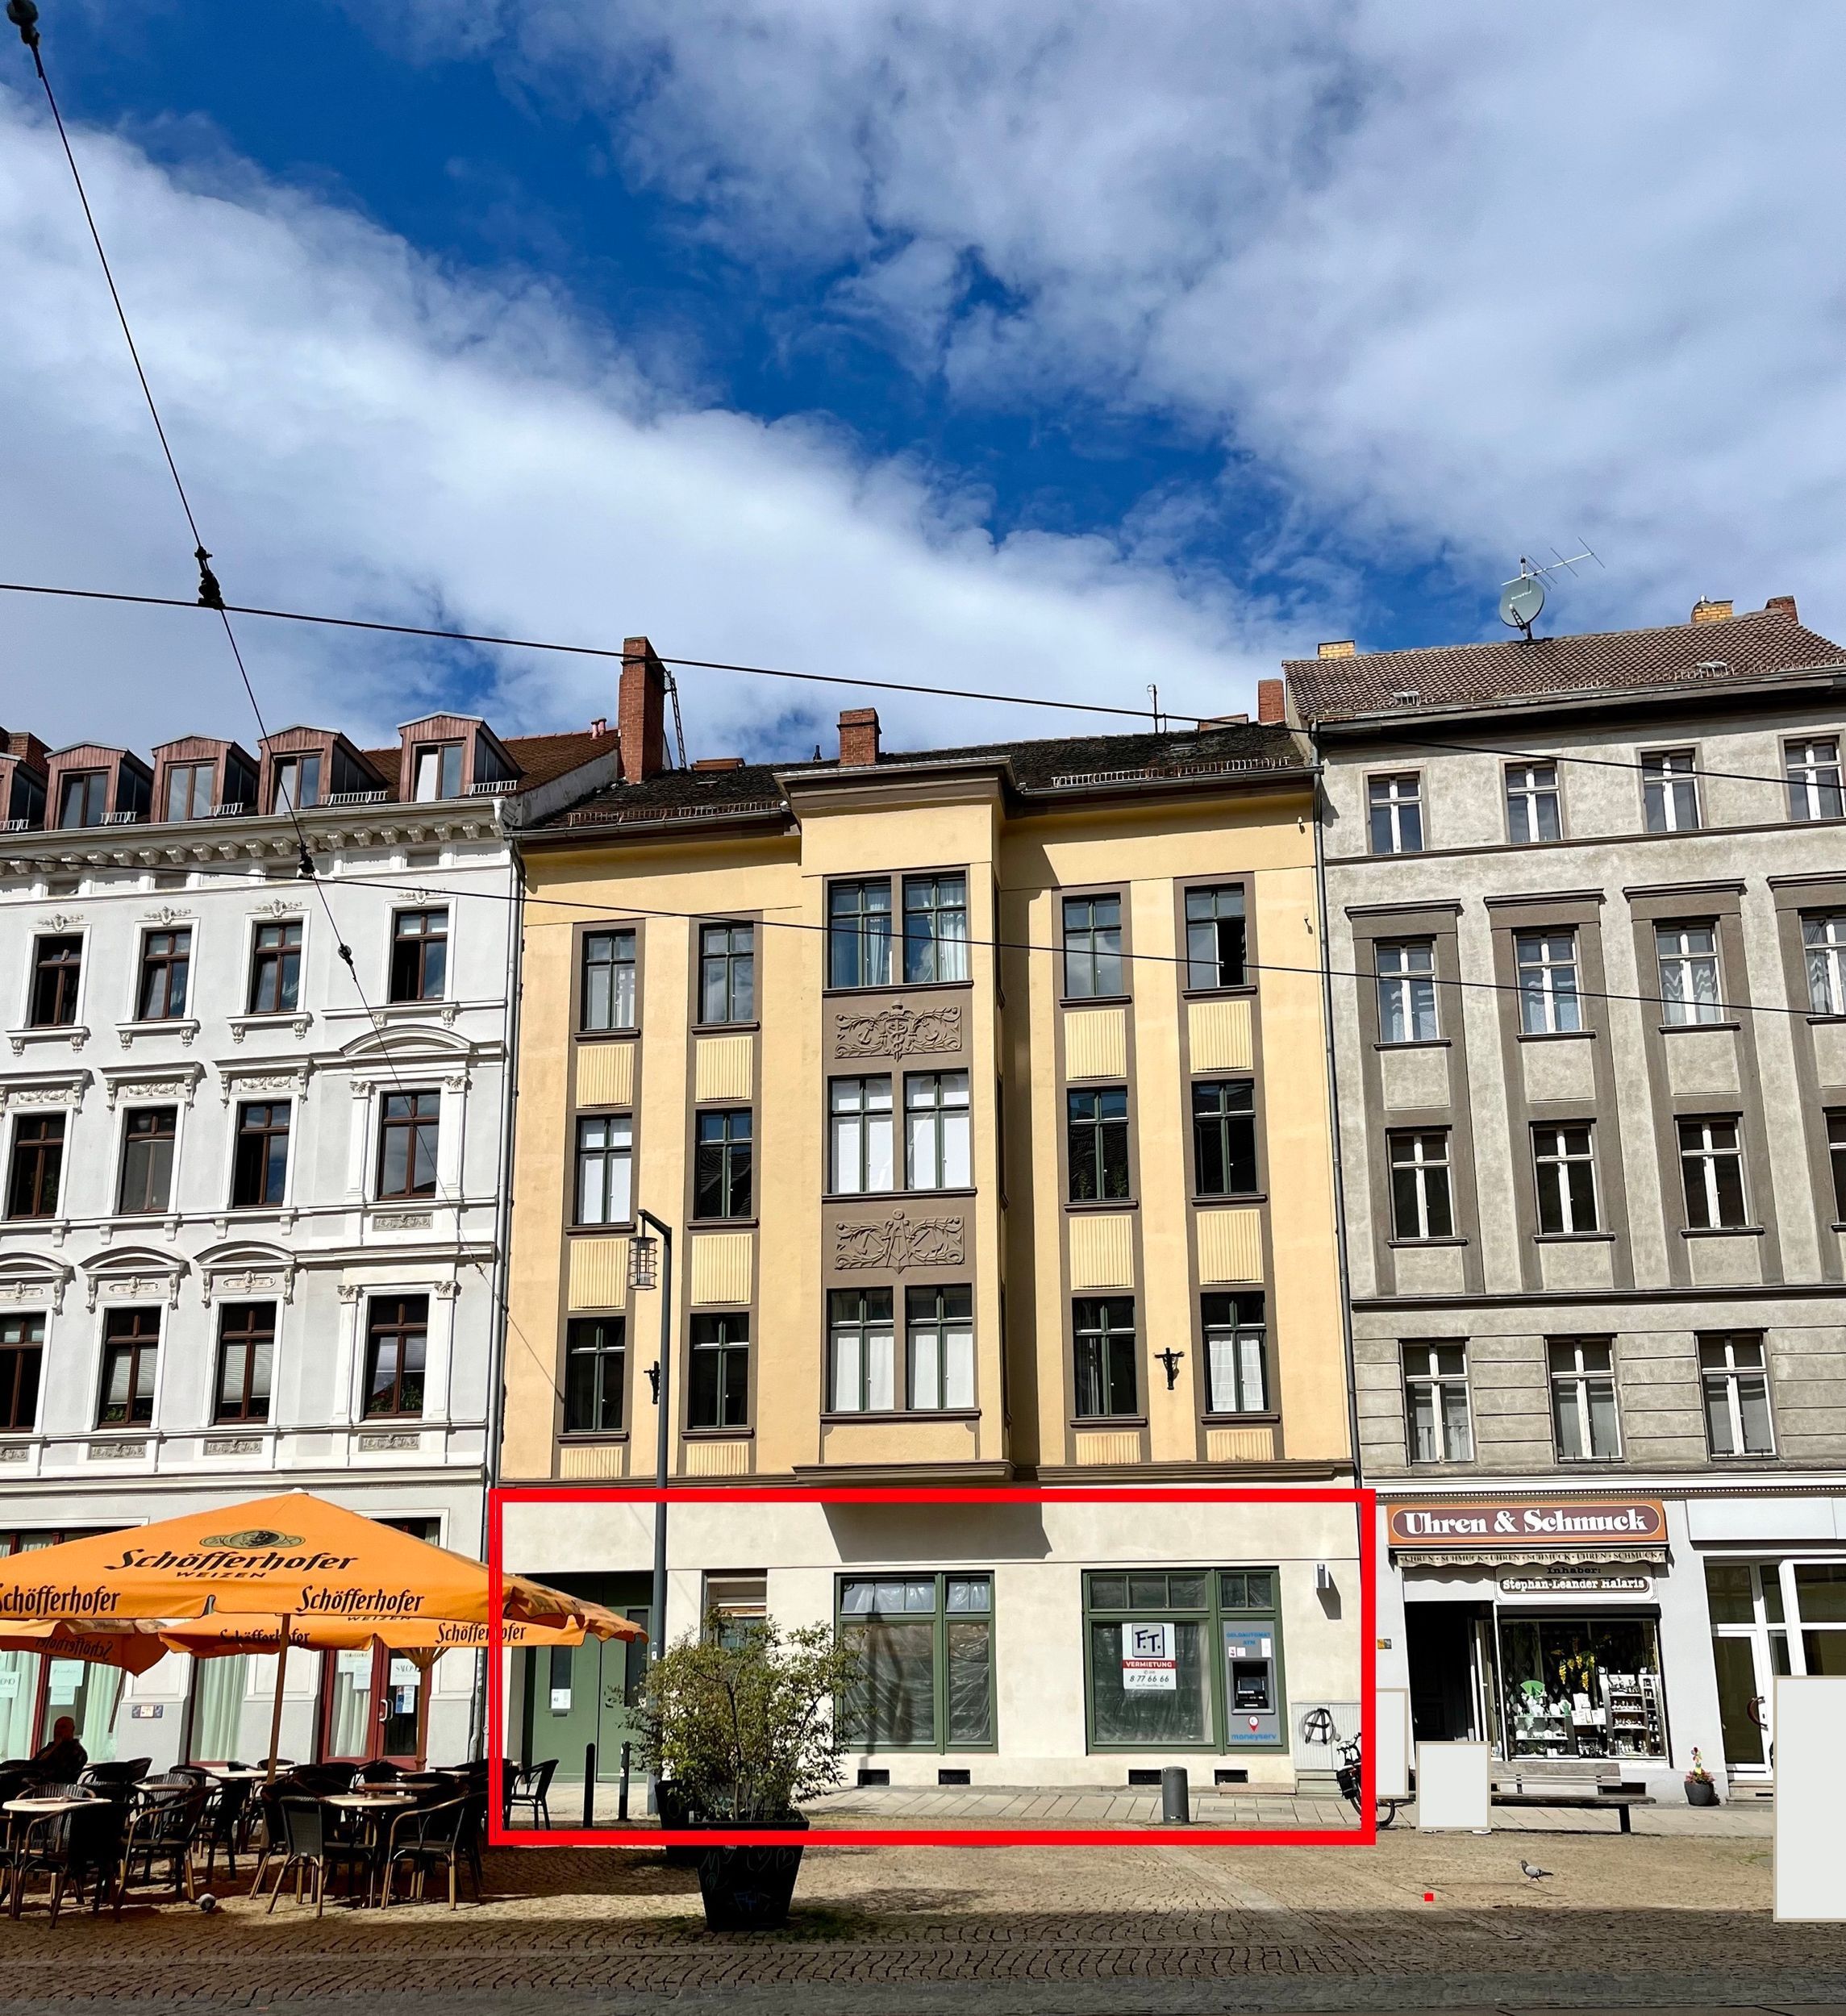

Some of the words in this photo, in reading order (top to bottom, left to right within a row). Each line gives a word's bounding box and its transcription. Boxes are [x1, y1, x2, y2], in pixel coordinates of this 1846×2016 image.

[1404, 1512, 1488, 1534] Uhren
[1494, 1510, 1519, 1533] &
[1523, 1508, 1648, 1533] Schmuck
[104, 1548, 359, 1572] Schöfferhofer
[1440, 1554, 1484, 1562] SCHMUCK
[1490, 1553, 1520, 1561] UHREN
[1527, 1552, 1570, 1560] SCHMUCK
[1577, 1552, 1606, 1560] UHREN
[1613, 1551, 1658, 1559] SCHMUCK
[1547, 1566, 1602, 1574] Inhaber:
[295, 1585, 425, 1614] Schöfferhofer
